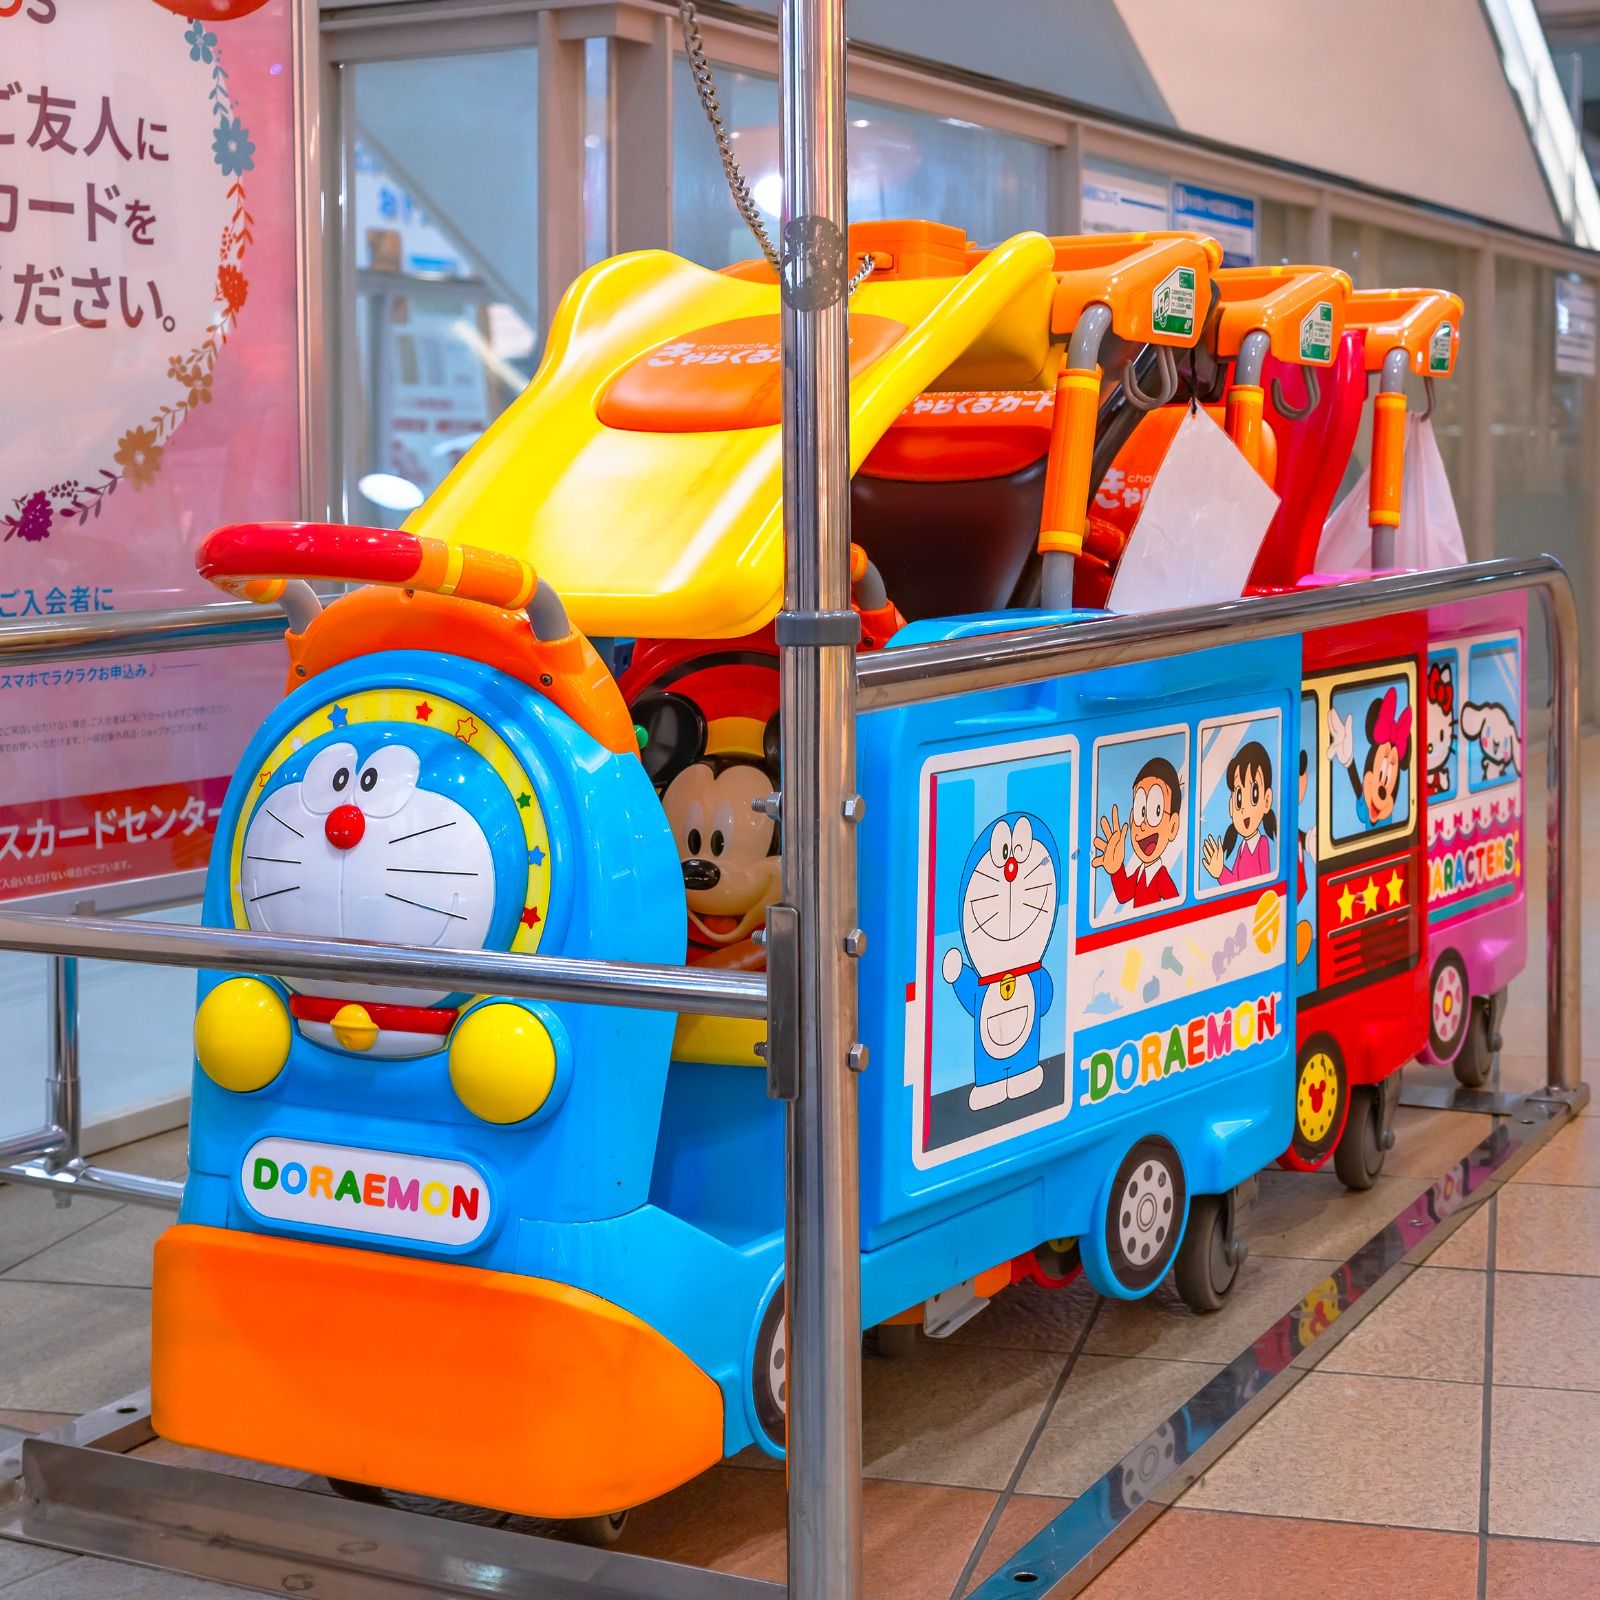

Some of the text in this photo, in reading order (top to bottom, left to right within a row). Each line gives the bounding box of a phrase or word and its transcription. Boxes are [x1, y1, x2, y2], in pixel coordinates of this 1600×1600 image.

[0, 264, 176, 333] ださい。
[647, 342, 781, 366] きゃらくる
[901, 394, 1055, 414] ゃらくるカート
[0, 586, 114, 617] ご入会者に
[1428, 834, 1515, 902] ARACTERS
[1089, 994, 1276, 1102] DORAEMON
[252, 1157, 480, 1221] DORAEMON
